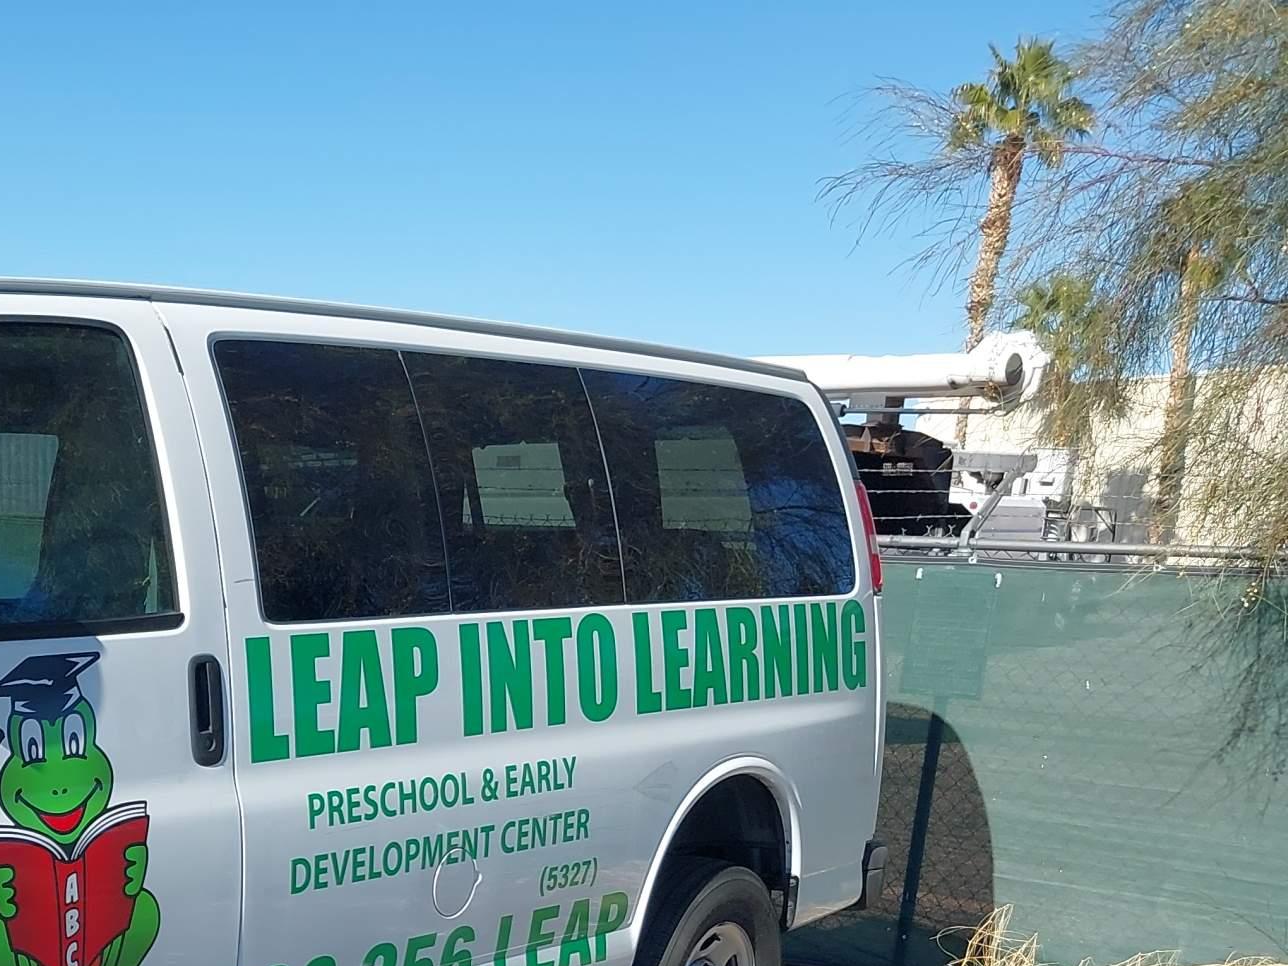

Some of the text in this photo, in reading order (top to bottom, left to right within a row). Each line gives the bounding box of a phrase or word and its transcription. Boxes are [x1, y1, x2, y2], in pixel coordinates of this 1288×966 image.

[245, 599, 868, 764] LEAP INTO LEARNING
[306, 755, 577, 830] PRESCHOOL & EARLY
[289, 808, 591, 896] DEVELOPMENT CENTER
[538, 857, 599, 896] (5327)
